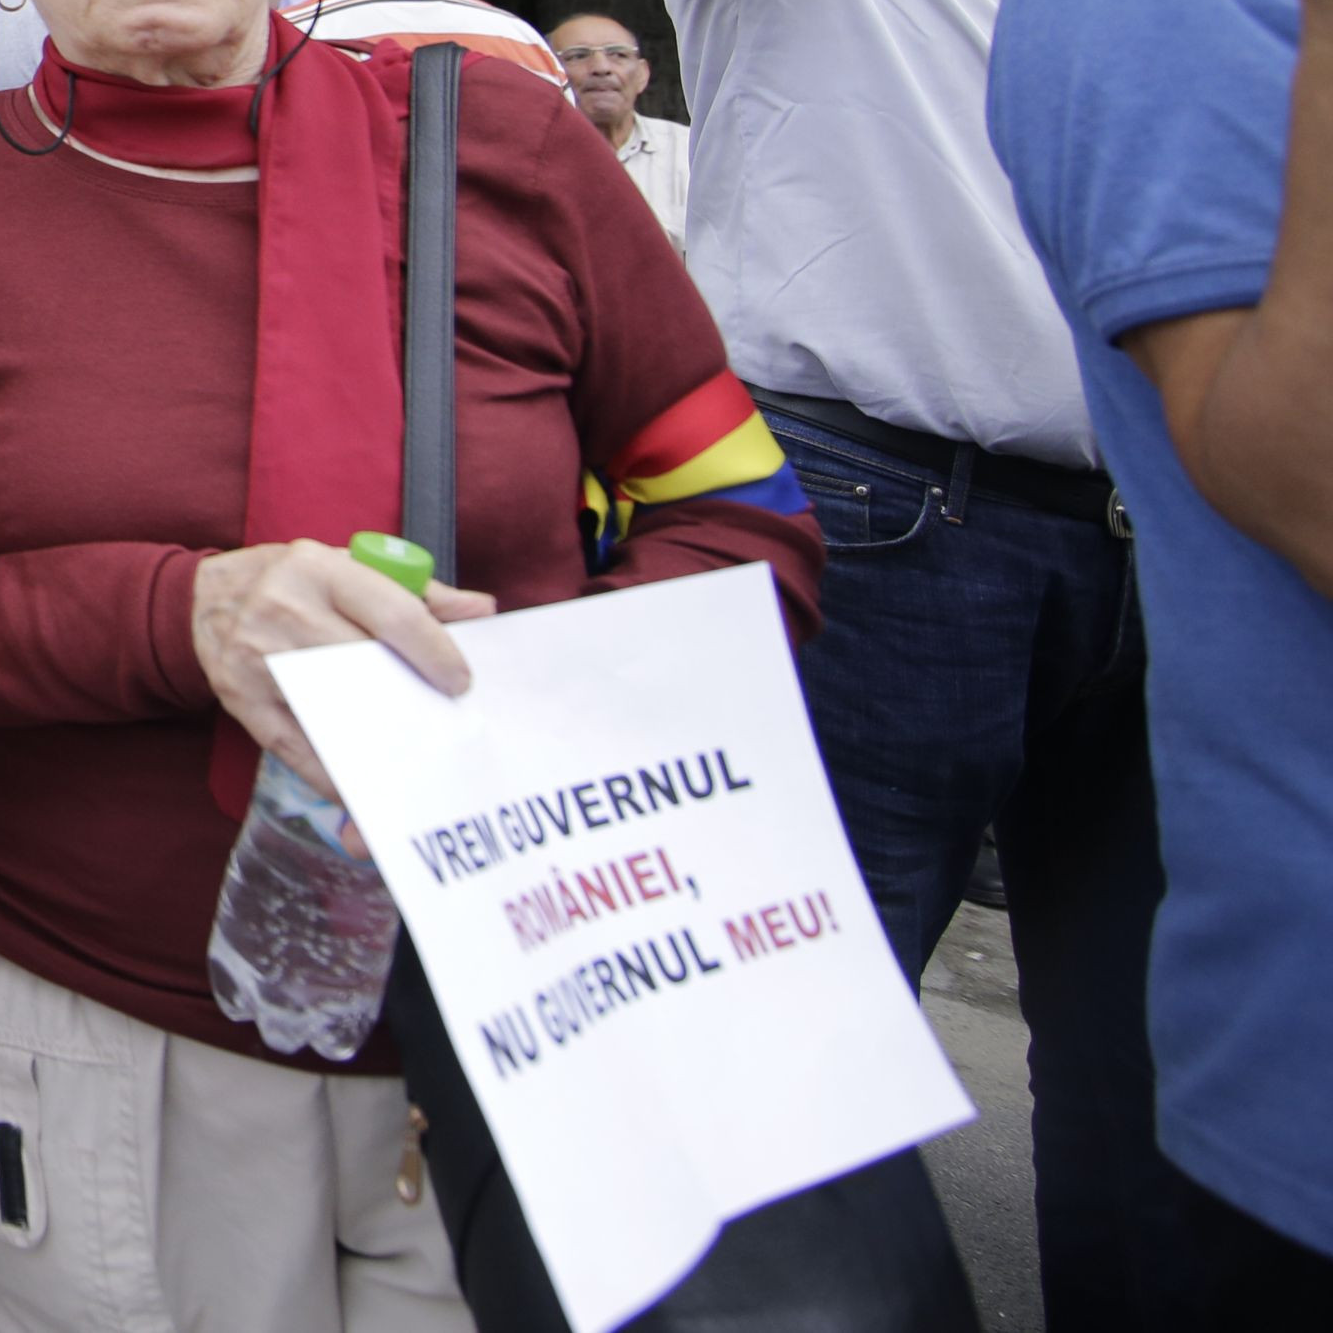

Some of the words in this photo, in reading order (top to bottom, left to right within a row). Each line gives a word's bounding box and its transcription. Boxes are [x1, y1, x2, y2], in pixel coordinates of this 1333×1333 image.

[411, 821, 502, 885] VREM
[500, 749, 753, 854] GUVERNUL
[503, 847, 702, 952] ROMÂNIEI,
[478, 1014, 538, 1080] NU
[535, 929, 721, 1046] GUVERNUL
[723, 890, 842, 963] MEU!
